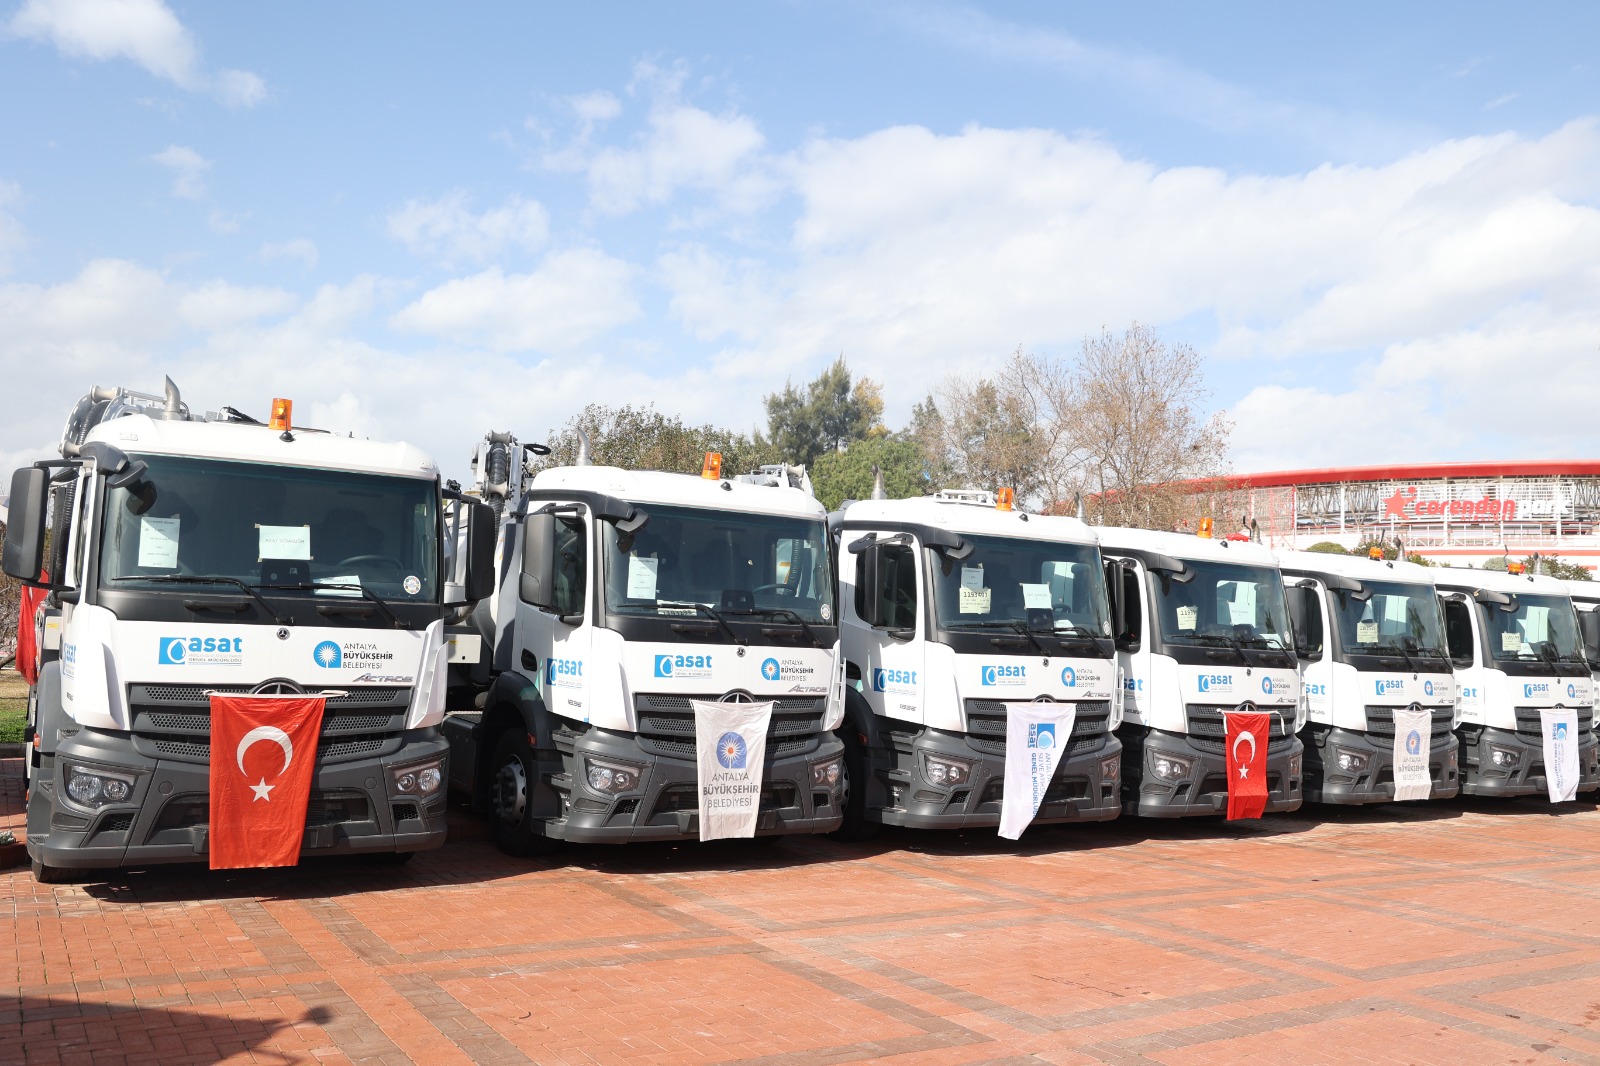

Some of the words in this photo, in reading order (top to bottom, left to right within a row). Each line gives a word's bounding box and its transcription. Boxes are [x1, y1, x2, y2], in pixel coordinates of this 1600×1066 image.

[1415, 495, 1516, 515] corendon
[1518, 495, 1570, 518] park
[188, 637, 243, 652] asat
[343, 651, 393, 660] BÜYÜKŞEHİR
[342, 661, 383, 669] BELEDİYESİ
[675, 655, 712, 668] asat
[557, 659, 583, 677] asat
[997, 666, 1026, 677] asat
[887, 669, 917, 685] asat
[1210, 675, 1232, 684] asat
[1385, 680, 1404, 689] asat
[1532, 683, 1549, 691] asat
[712, 772, 749, 781] ANTALYA
[703, 782, 759, 796] BÜYÜKŞEHİR
[708, 796, 752, 808] BELEDİYESİ
